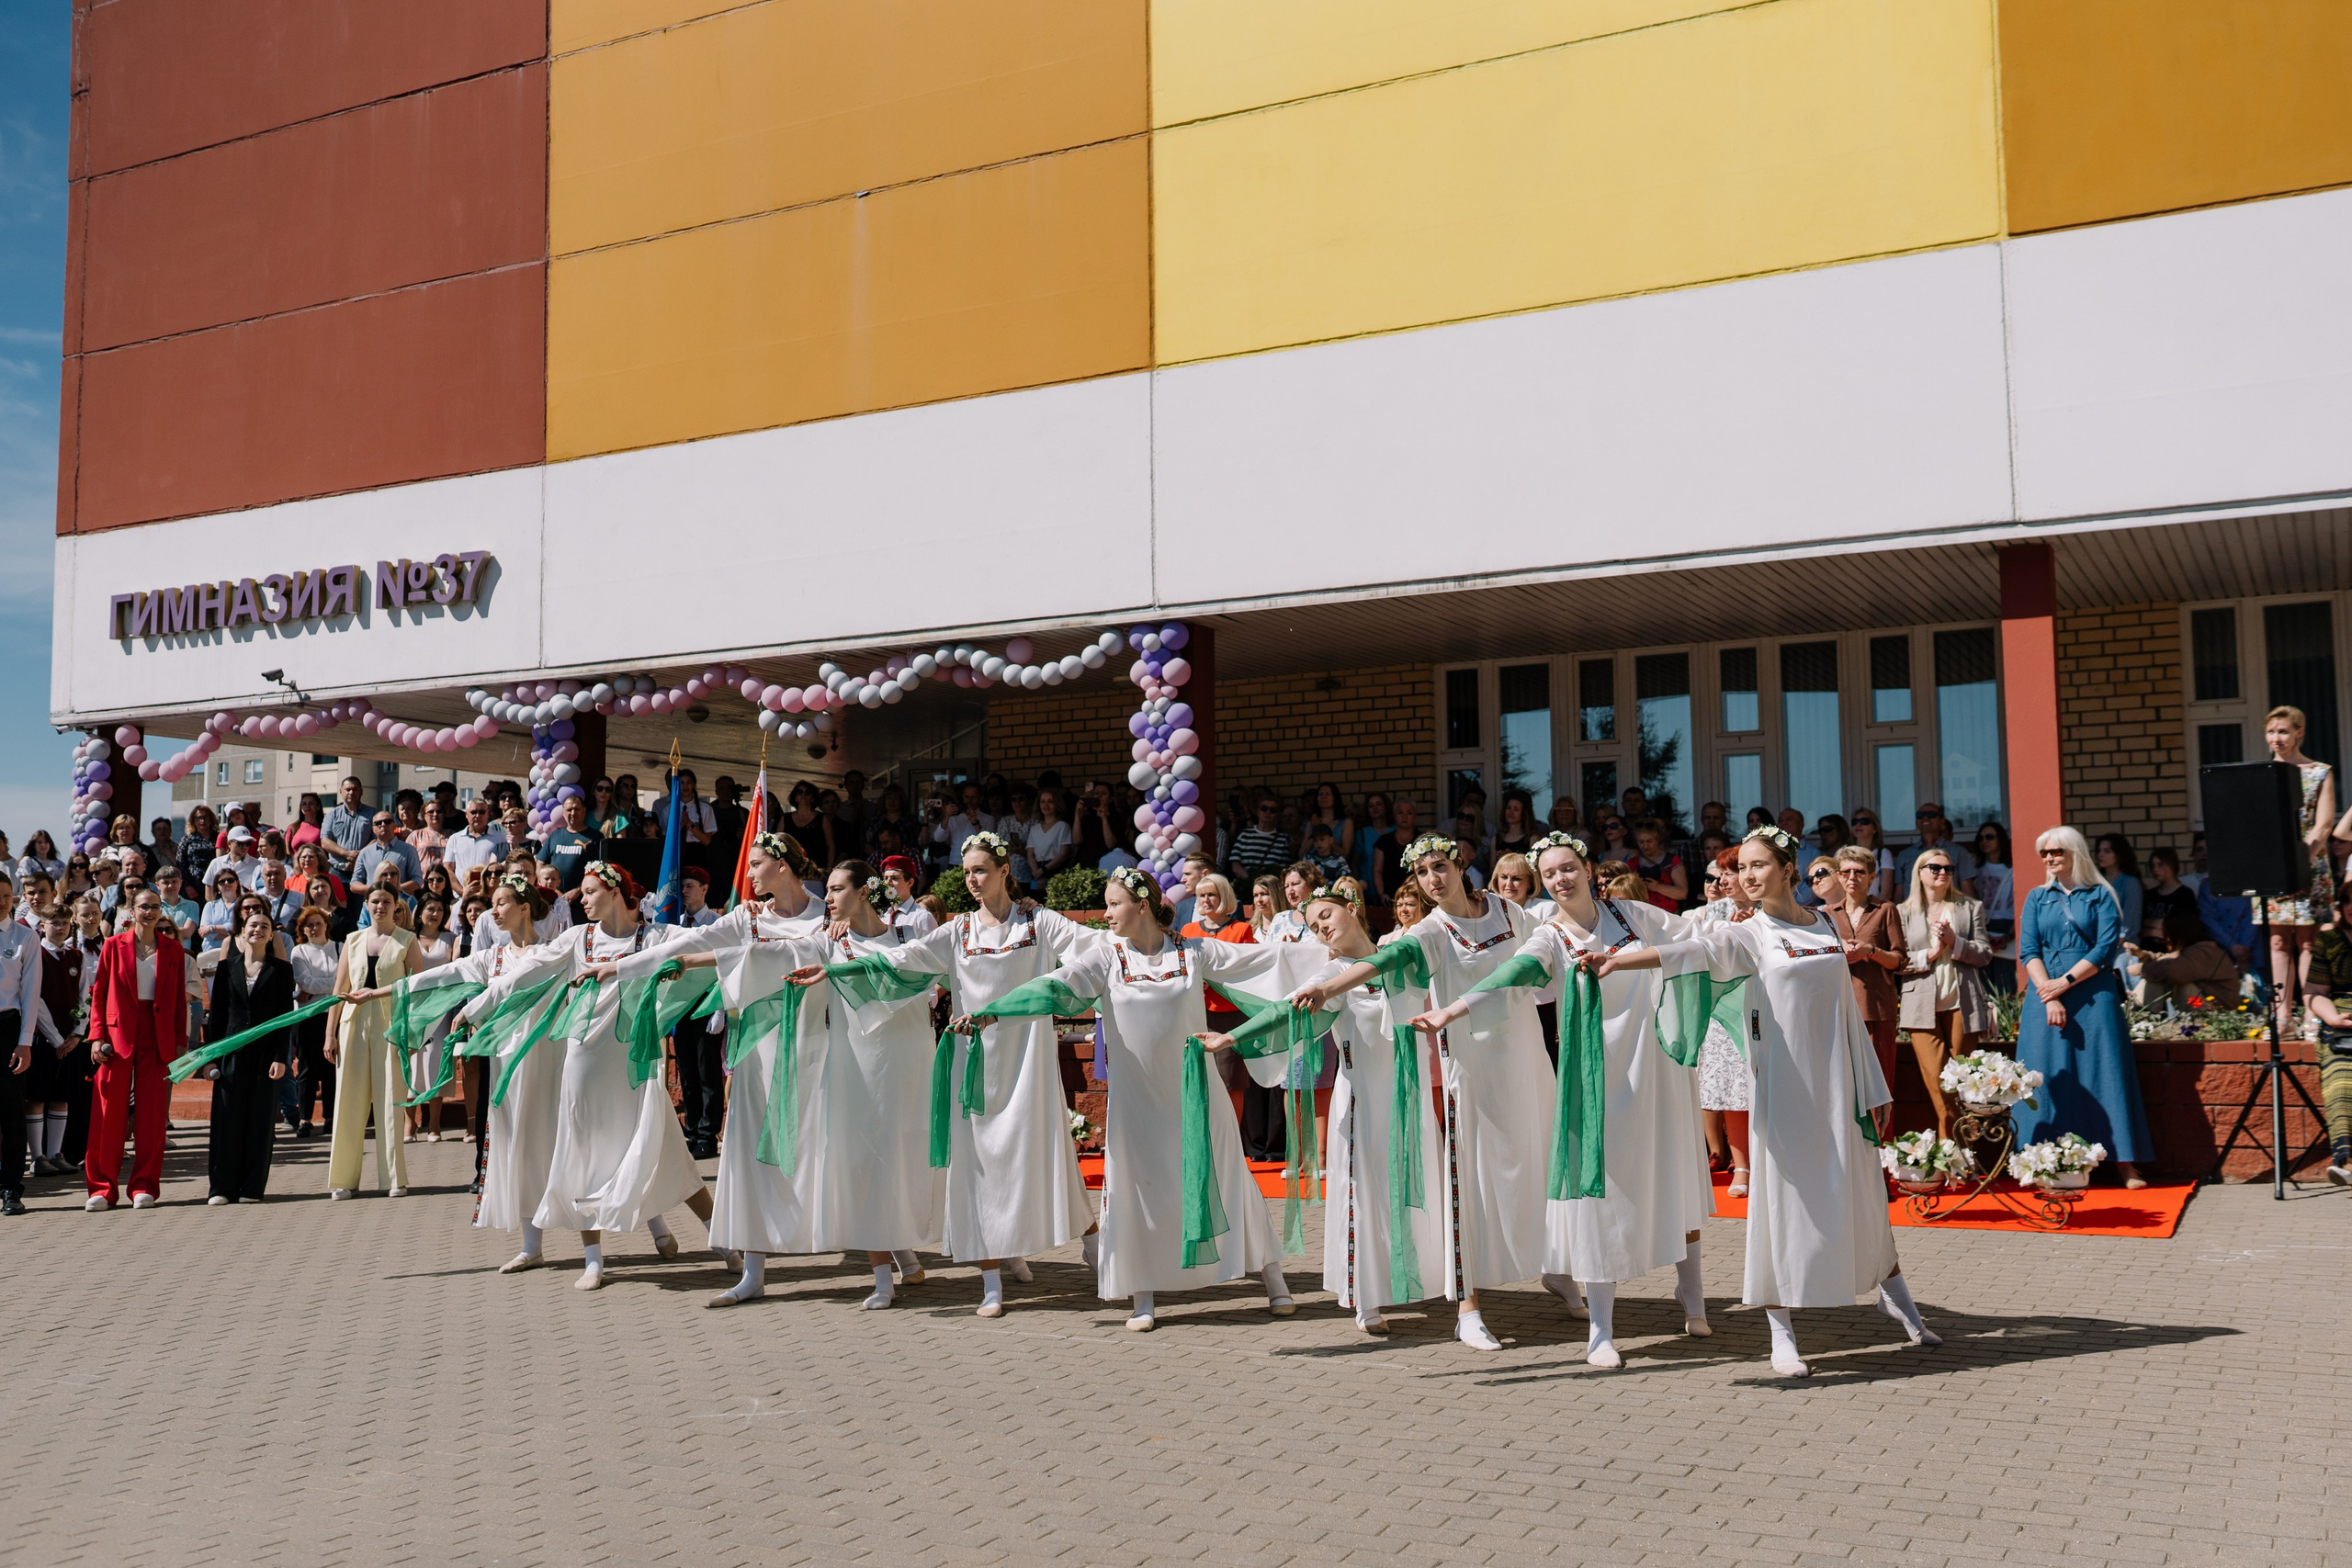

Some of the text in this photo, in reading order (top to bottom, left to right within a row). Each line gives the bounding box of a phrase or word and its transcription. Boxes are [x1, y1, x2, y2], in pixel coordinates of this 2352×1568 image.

[109, 550, 490, 640] ГИМНАЗИЯ №37
[555, 844, 582, 855] PUMA
